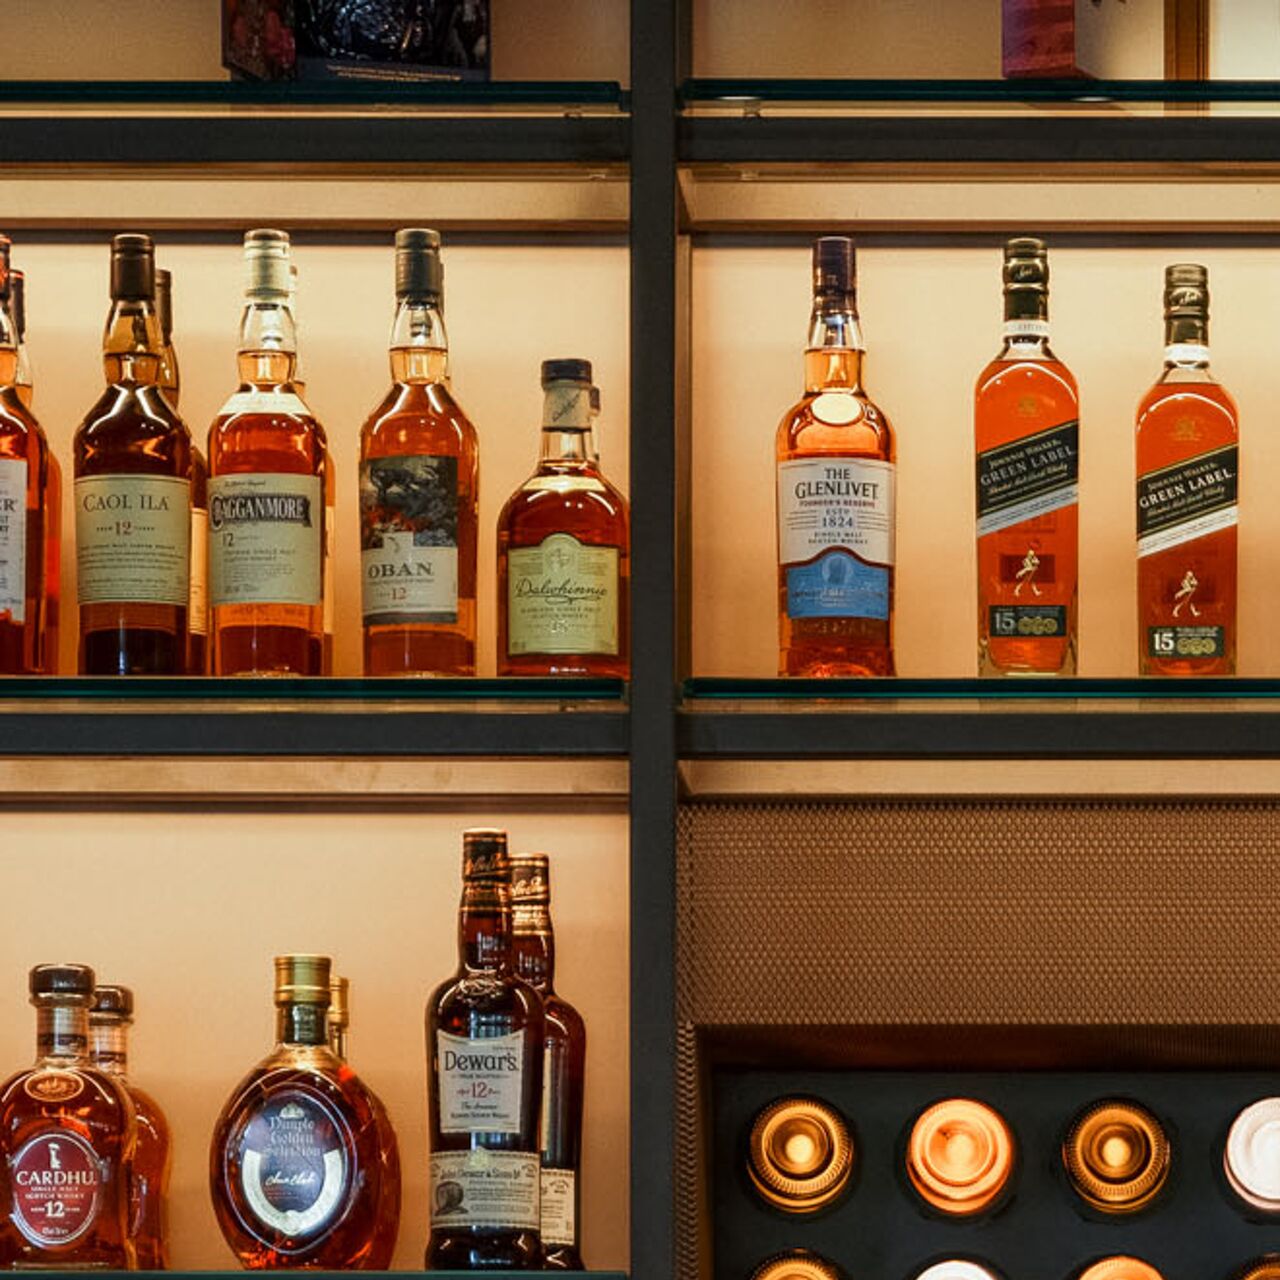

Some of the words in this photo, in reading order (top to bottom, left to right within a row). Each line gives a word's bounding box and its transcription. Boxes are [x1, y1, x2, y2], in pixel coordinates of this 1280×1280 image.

[824, 467, 851, 480] THE
[980, 461, 1027, 485] GREEN
[1030, 445, 1072, 468] LABEL
[795, 481, 878, 500] GLENLIVET
[1140, 483, 1185, 508] GREEN
[1188, 468, 1232, 491] LABEL
[83, 494, 133, 512] CAOL
[140, 495, 169, 511] ILA
[115, 521, 132, 536] 12
[822, 517, 853, 528] 1824
[367, 563, 433, 579] OBAN
[391, 587, 407, 600] 12
[995, 612, 1015, 630] 15
[1154, 633, 1175, 651] 15
[444, 1050, 519, 1072] Dewar's
[472, 1081, 488, 1098] 12
[16, 1170, 94, 1186] CARDHU
[44, 1201, 65, 1218] 12
